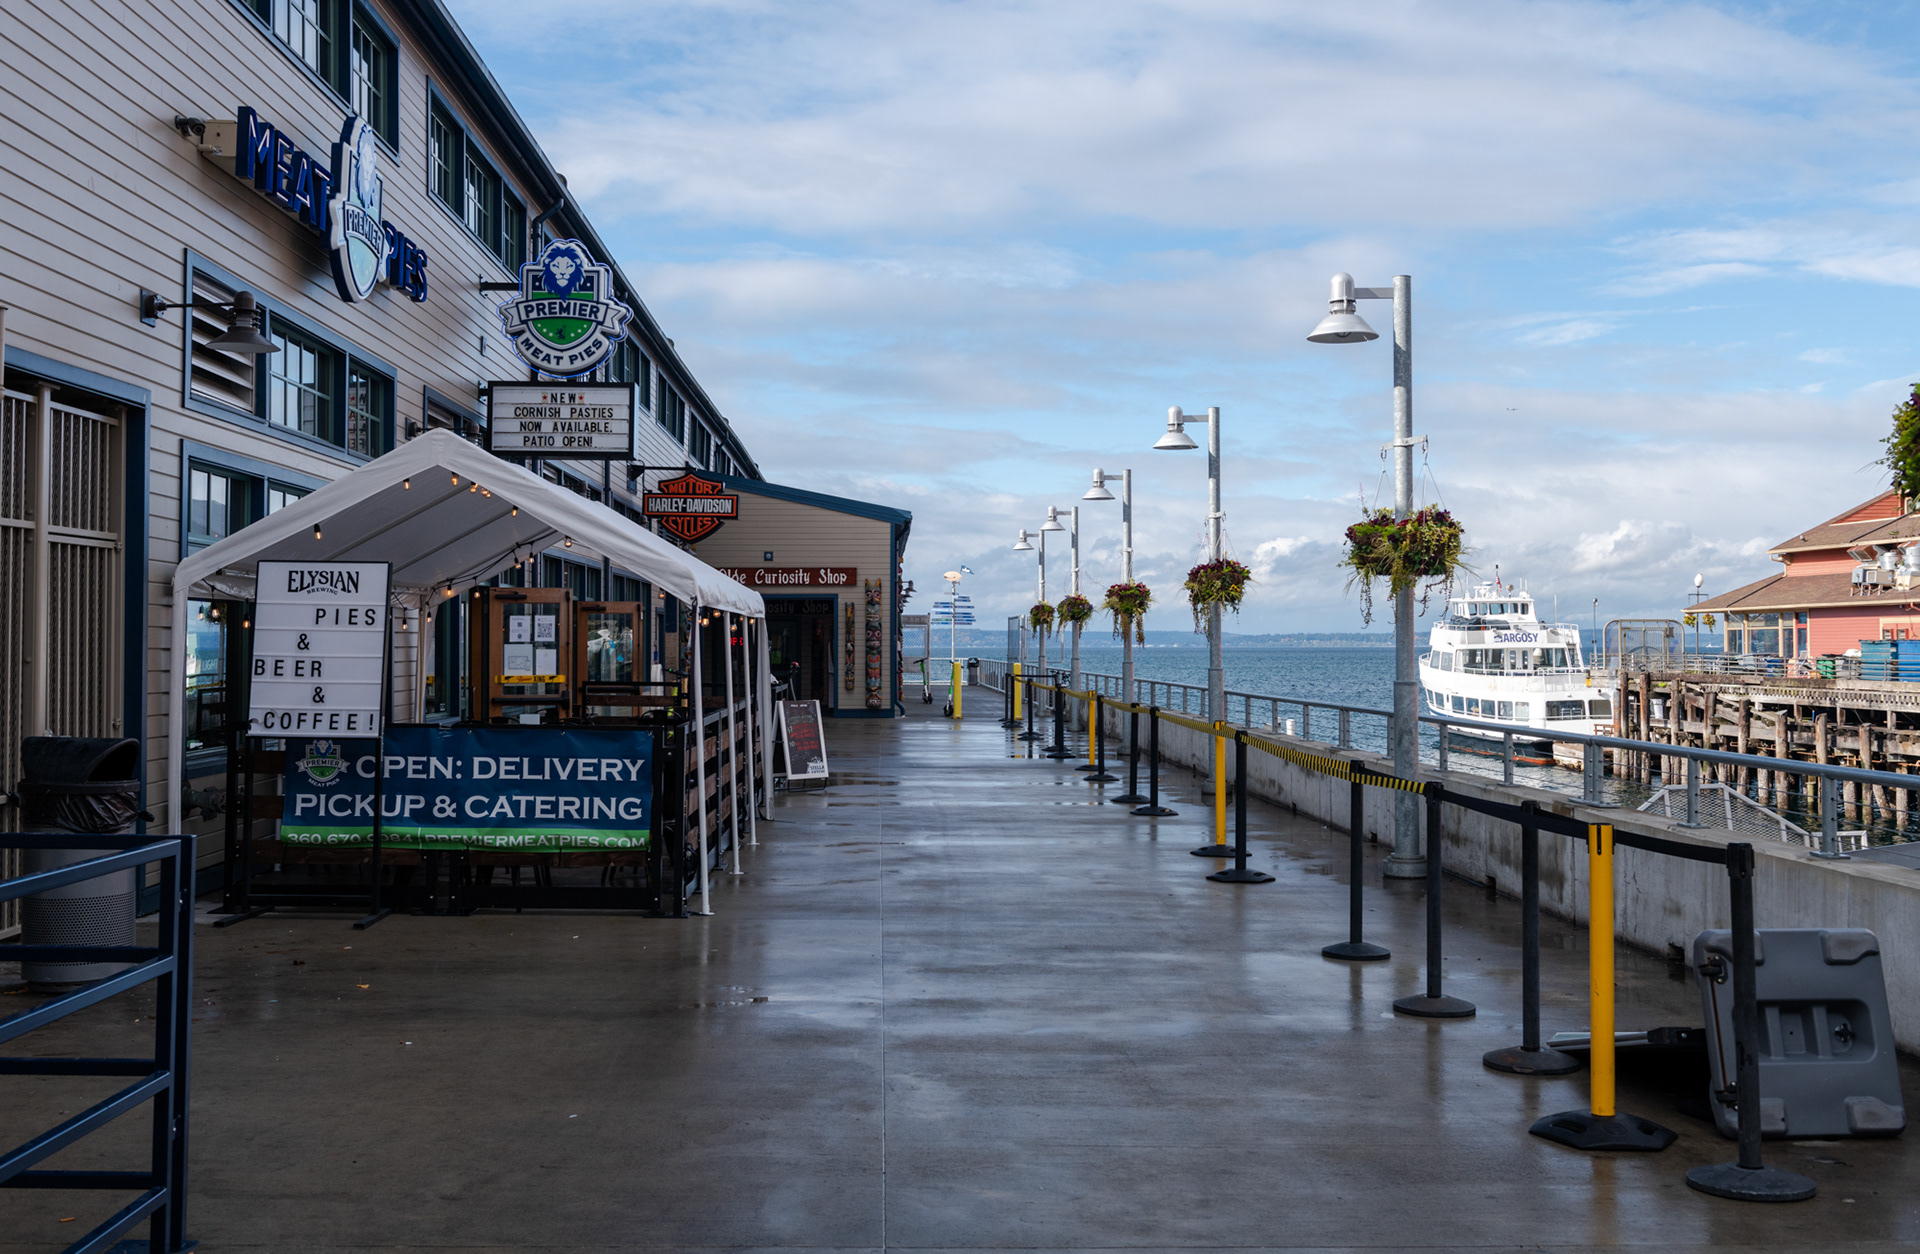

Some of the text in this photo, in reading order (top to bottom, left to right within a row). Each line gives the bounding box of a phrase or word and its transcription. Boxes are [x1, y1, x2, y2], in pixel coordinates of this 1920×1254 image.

[235, 106, 427, 303] MEAT PIES
[346, 208, 381, 254] PREMIER
[523, 301, 601, 320] PREMIER
[520, 336, 603, 366] MEAT PIES
[550, 392, 577, 404] NEW
[514, 406, 614, 418] CORNISH PASTIES
[520, 421, 613, 433] NOW AVAILABLE.
[523, 436, 593, 447] PATIO OPEN!
[668, 478, 713, 494] MOTOR
[648, 498, 732, 513] HARLEY-DAVIDSON
[668, 516, 712, 536] CYCLES
[287, 570, 360, 593] ELYSIAN
[755, 568, 811, 585] Curiosity
[818, 568, 847, 585] Shop
[306, 587, 339, 596] BREWING
[802, 599, 829, 614] Shop
[315, 608, 376, 626] PIES
[297, 633, 310, 650] &
[1503, 632, 1539, 643] ARGOSY
[253, 658, 322, 678] BEER
[312, 686, 325, 704] &
[263, 711, 374, 731] COFFEE!
[305, 758, 340, 767] PREMIER
[355, 755, 646, 782] OPEN: DELIVERY
[307, 777, 340, 788] MEAT PIES
[294, 793, 643, 820] PICKUP & CATERING
